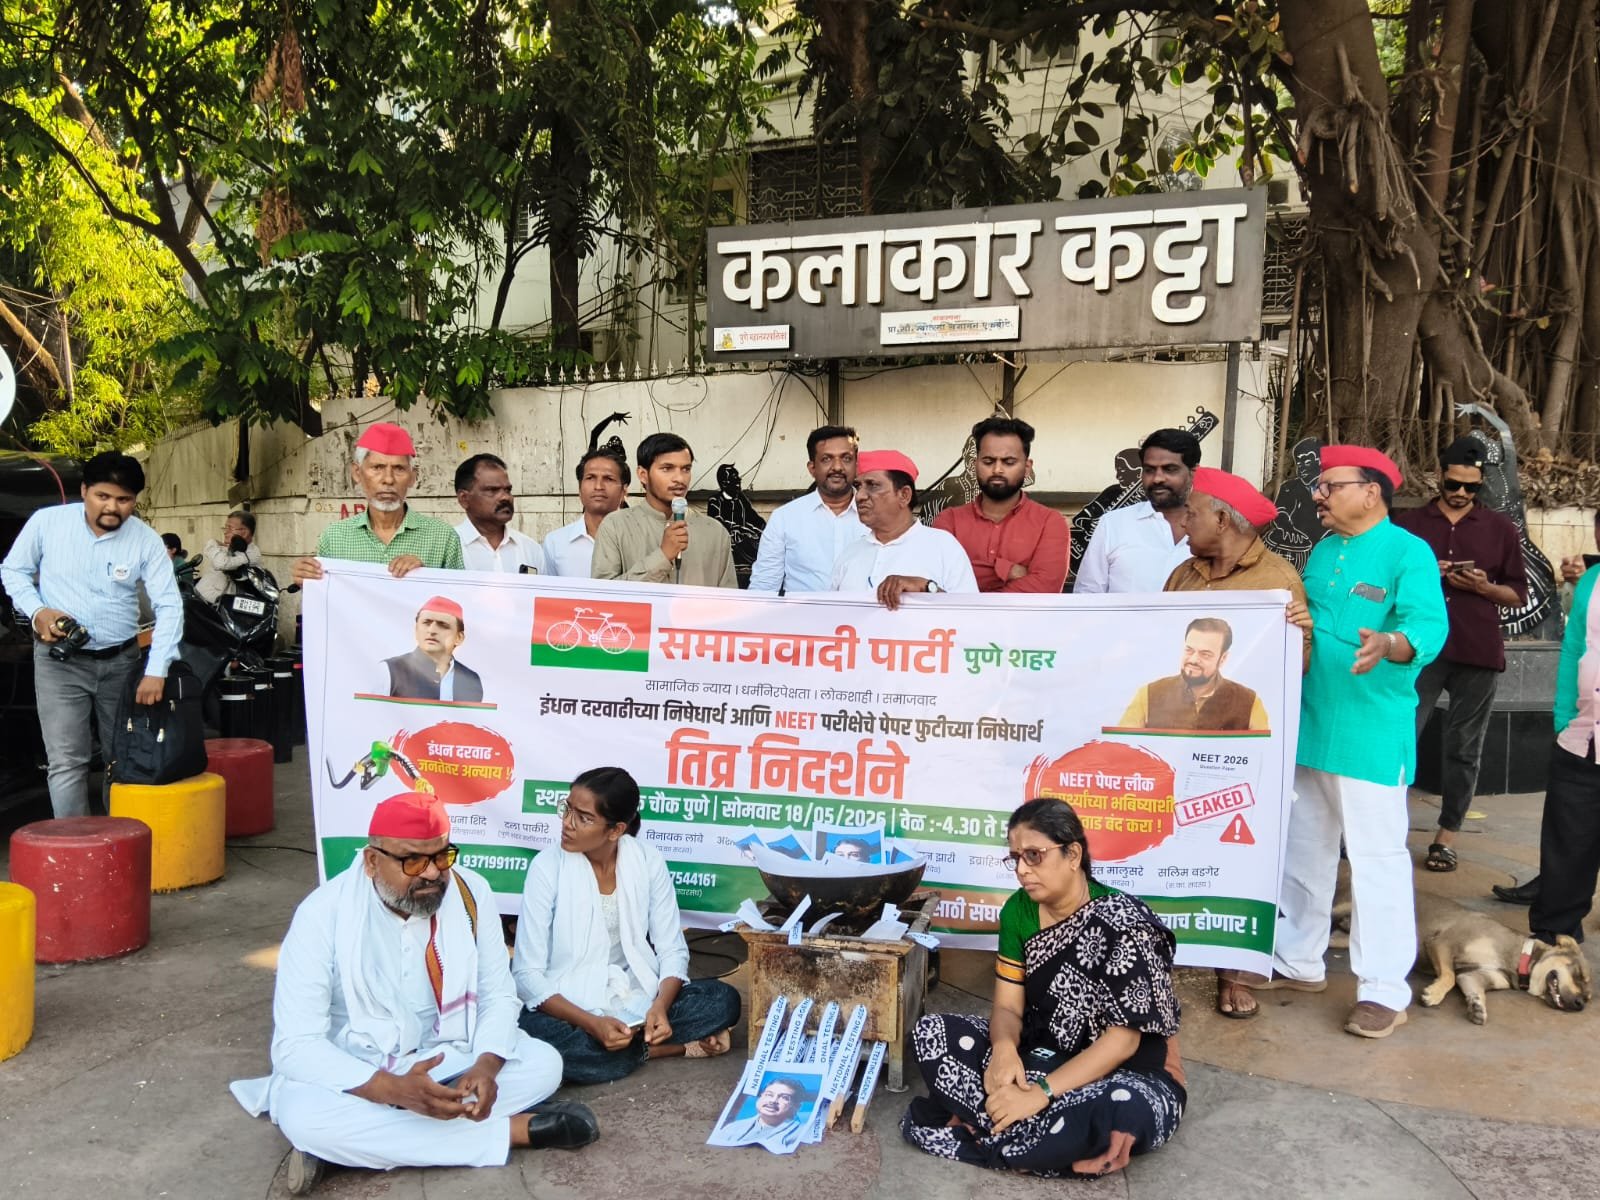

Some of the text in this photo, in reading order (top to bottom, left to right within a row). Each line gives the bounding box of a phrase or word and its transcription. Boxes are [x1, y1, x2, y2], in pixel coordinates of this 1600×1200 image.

[717, 203, 1248, 323] कलाकार कट्टा
[658, 625, 1057, 675] समाजवादी पार्टी पुणे शहर
[645, 679, 699, 694] सामाजिक
[702, 682, 732, 696] न्याय
[741, 682, 811, 701] धर्मनिरपेक्षता
[820, 687, 873, 704] लोकशाही
[882, 693, 938, 707] समाजवाद
[539, 693, 1044, 743] इंधन दरवाढीच्या निषेधार्थ आणि NEET परीक्षेचे पेपर फुटीच्या निषेधार्थ
[427, 741, 454, 757] इंधन
[455, 746, 493, 760] दरवाढ
[665, 727, 910, 800] तिव्र निदर्शने
[1191, 752, 1249, 766] NEET 2026
[418, 758, 459, 776] जनतेवर
[462, 765, 500, 780] अन्याय
[1059, 770, 1156, 792] NEET पेपर लीक
[649, 788, 683, 813] चौक
[682, 796, 711, 821] पुणे
[721, 796, 785, 822] सोमवार
[784, 803, 887, 830] 18/05/2026
[899, 810, 927, 831] वेळ
[984, 818, 1002, 839] ते
[1182, 790, 1245, 822] LEAKED
[646, 829, 682, 842] विनायक
[1104, 812, 1124, 832] बंद
[1126, 818, 1154, 833] करा
[463, 854, 529, 871] 9371991173
[1106, 864, 1144, 879] मालुसरे
[1157, 865, 1189, 879] सलिम
[1192, 908, 1248, 933] होणार
[787, 1020, 802, 1056] TESTING
[823, 1012, 836, 1039] TESTING
[751, 1048, 767, 1090] NATIONAL
[764, 1015, 780, 1047] TESTING
[829, 1059, 848, 1095] NATIONAL
[845, 1021, 860, 1060] TESTING
